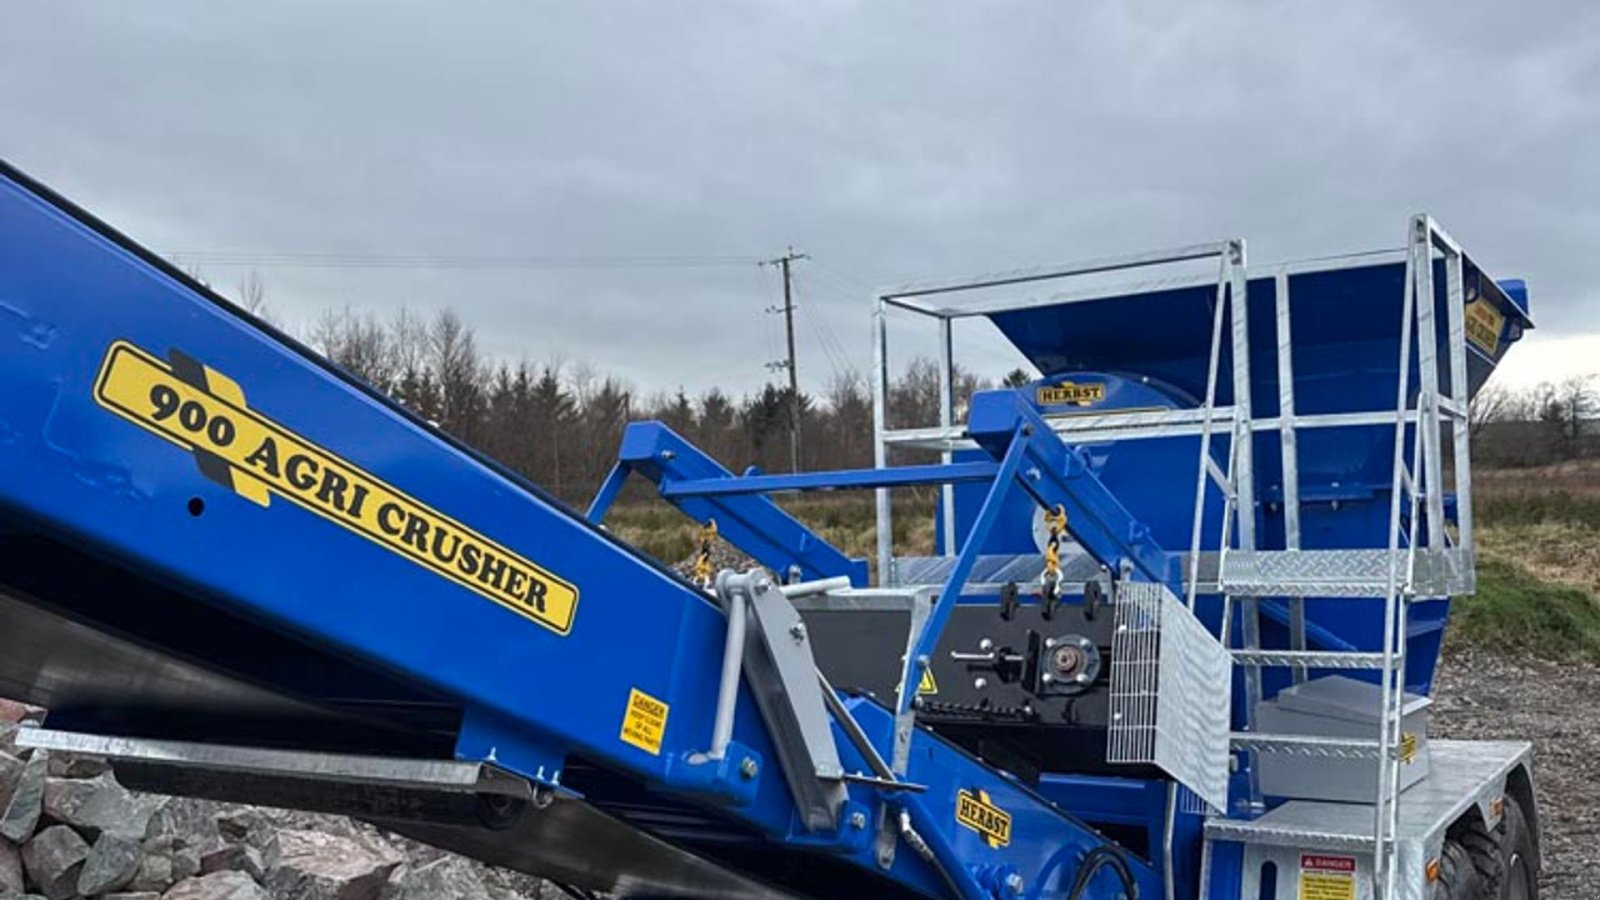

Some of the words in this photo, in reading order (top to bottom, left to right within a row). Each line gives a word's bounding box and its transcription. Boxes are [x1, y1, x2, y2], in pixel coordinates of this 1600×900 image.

[1043, 388, 1100, 402] HERBST
[149, 383, 236, 447] 900
[245, 437, 371, 519] AGRI
[377, 503, 548, 614] CRUSHER
[960, 798, 1008, 836] HERBST
[1315, 858, 1351, 869] DANGER
